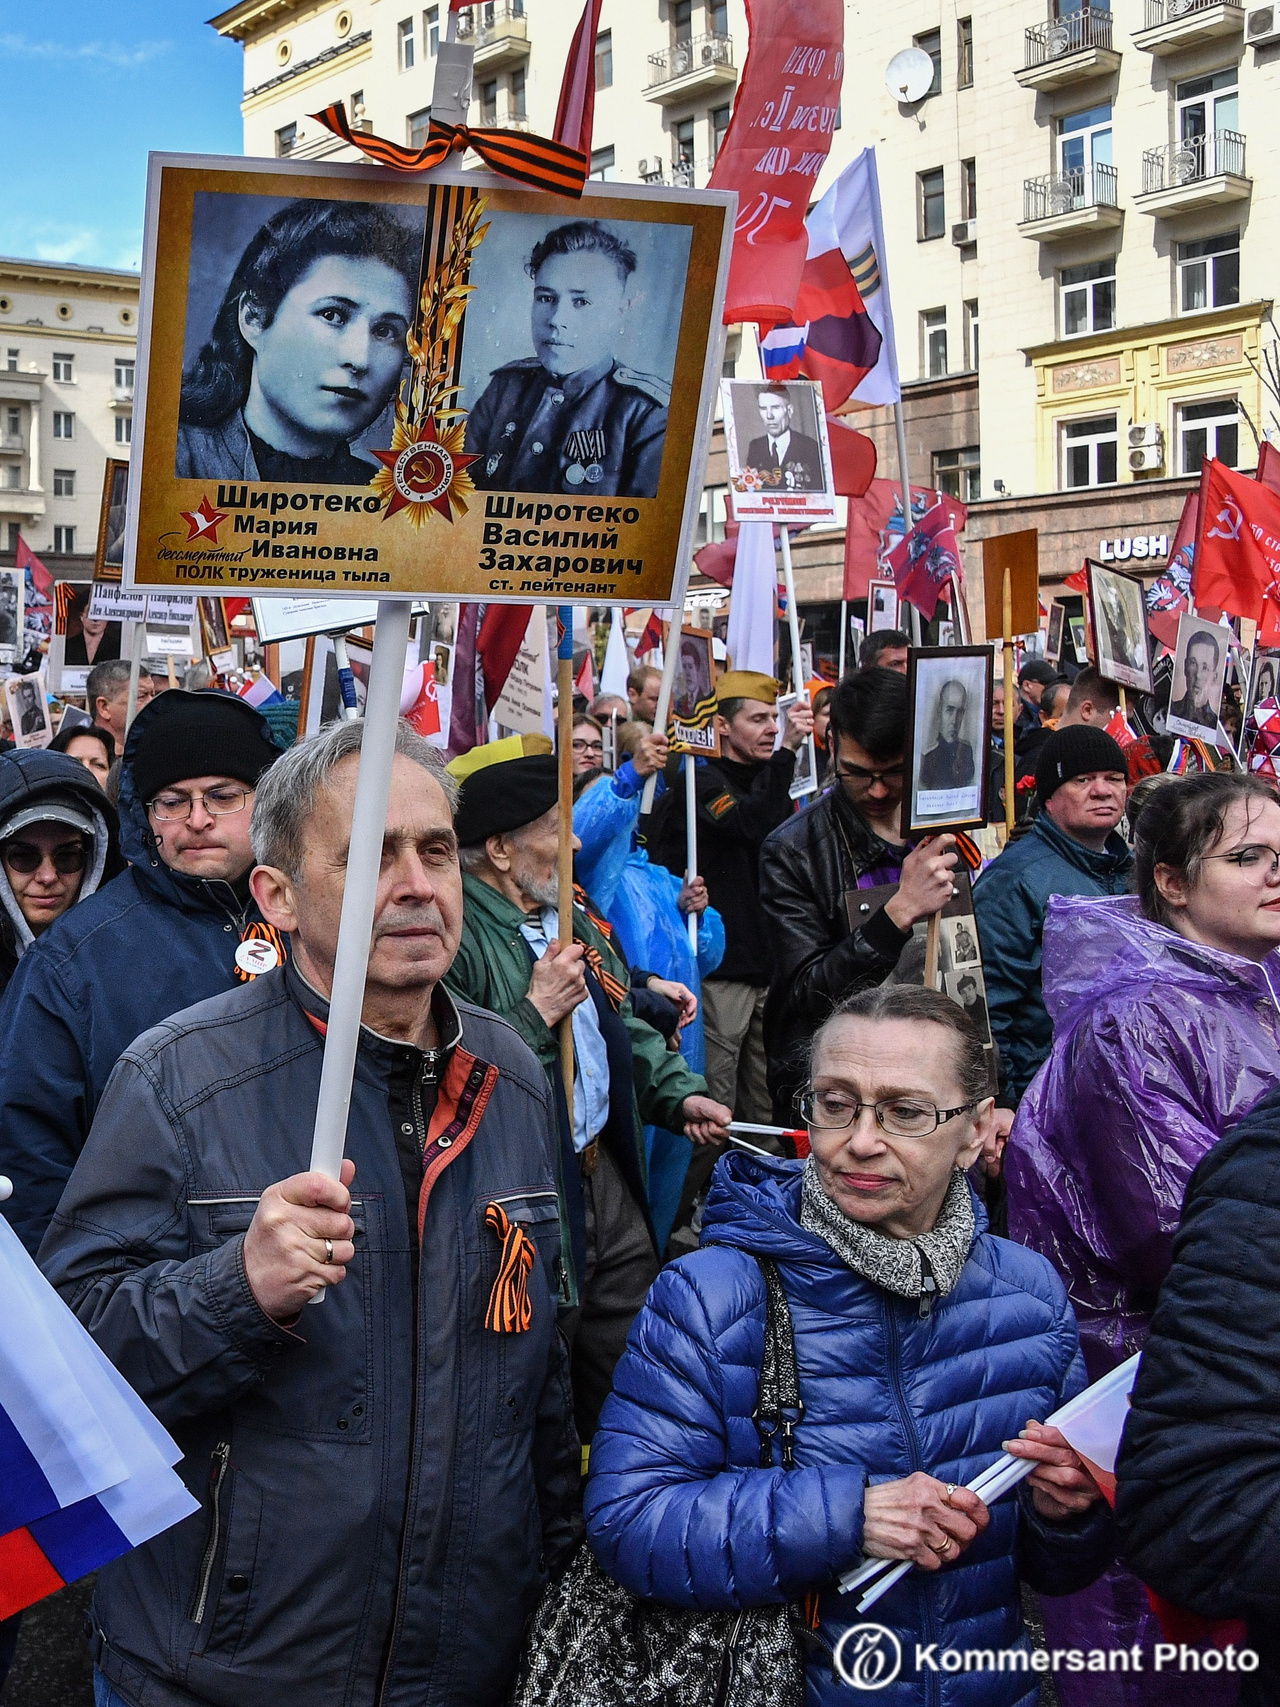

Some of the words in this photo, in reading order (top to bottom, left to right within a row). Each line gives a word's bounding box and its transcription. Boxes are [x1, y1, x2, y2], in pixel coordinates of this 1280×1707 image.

[396, 443, 448, 497] ОТЕЧЕСТВЕННАЯ
[216, 485, 381, 515] Широтеко
[484, 495, 640, 525] Широтеко
[234, 515, 318, 538] Мария
[482, 522, 619, 550] Василий
[157, 532, 252, 564] бессмертный
[251, 540, 379, 562] Ивановна
[1099, 534, 1169, 561] LUSH
[175, 565, 224, 580] ПОЛК
[229, 566, 336, 582] труженица
[342, 569, 391, 582] тыла
[478, 547, 643, 577] Захарович
[489, 579, 514, 591] ст.
[519, 578, 617, 594] лейтенант
